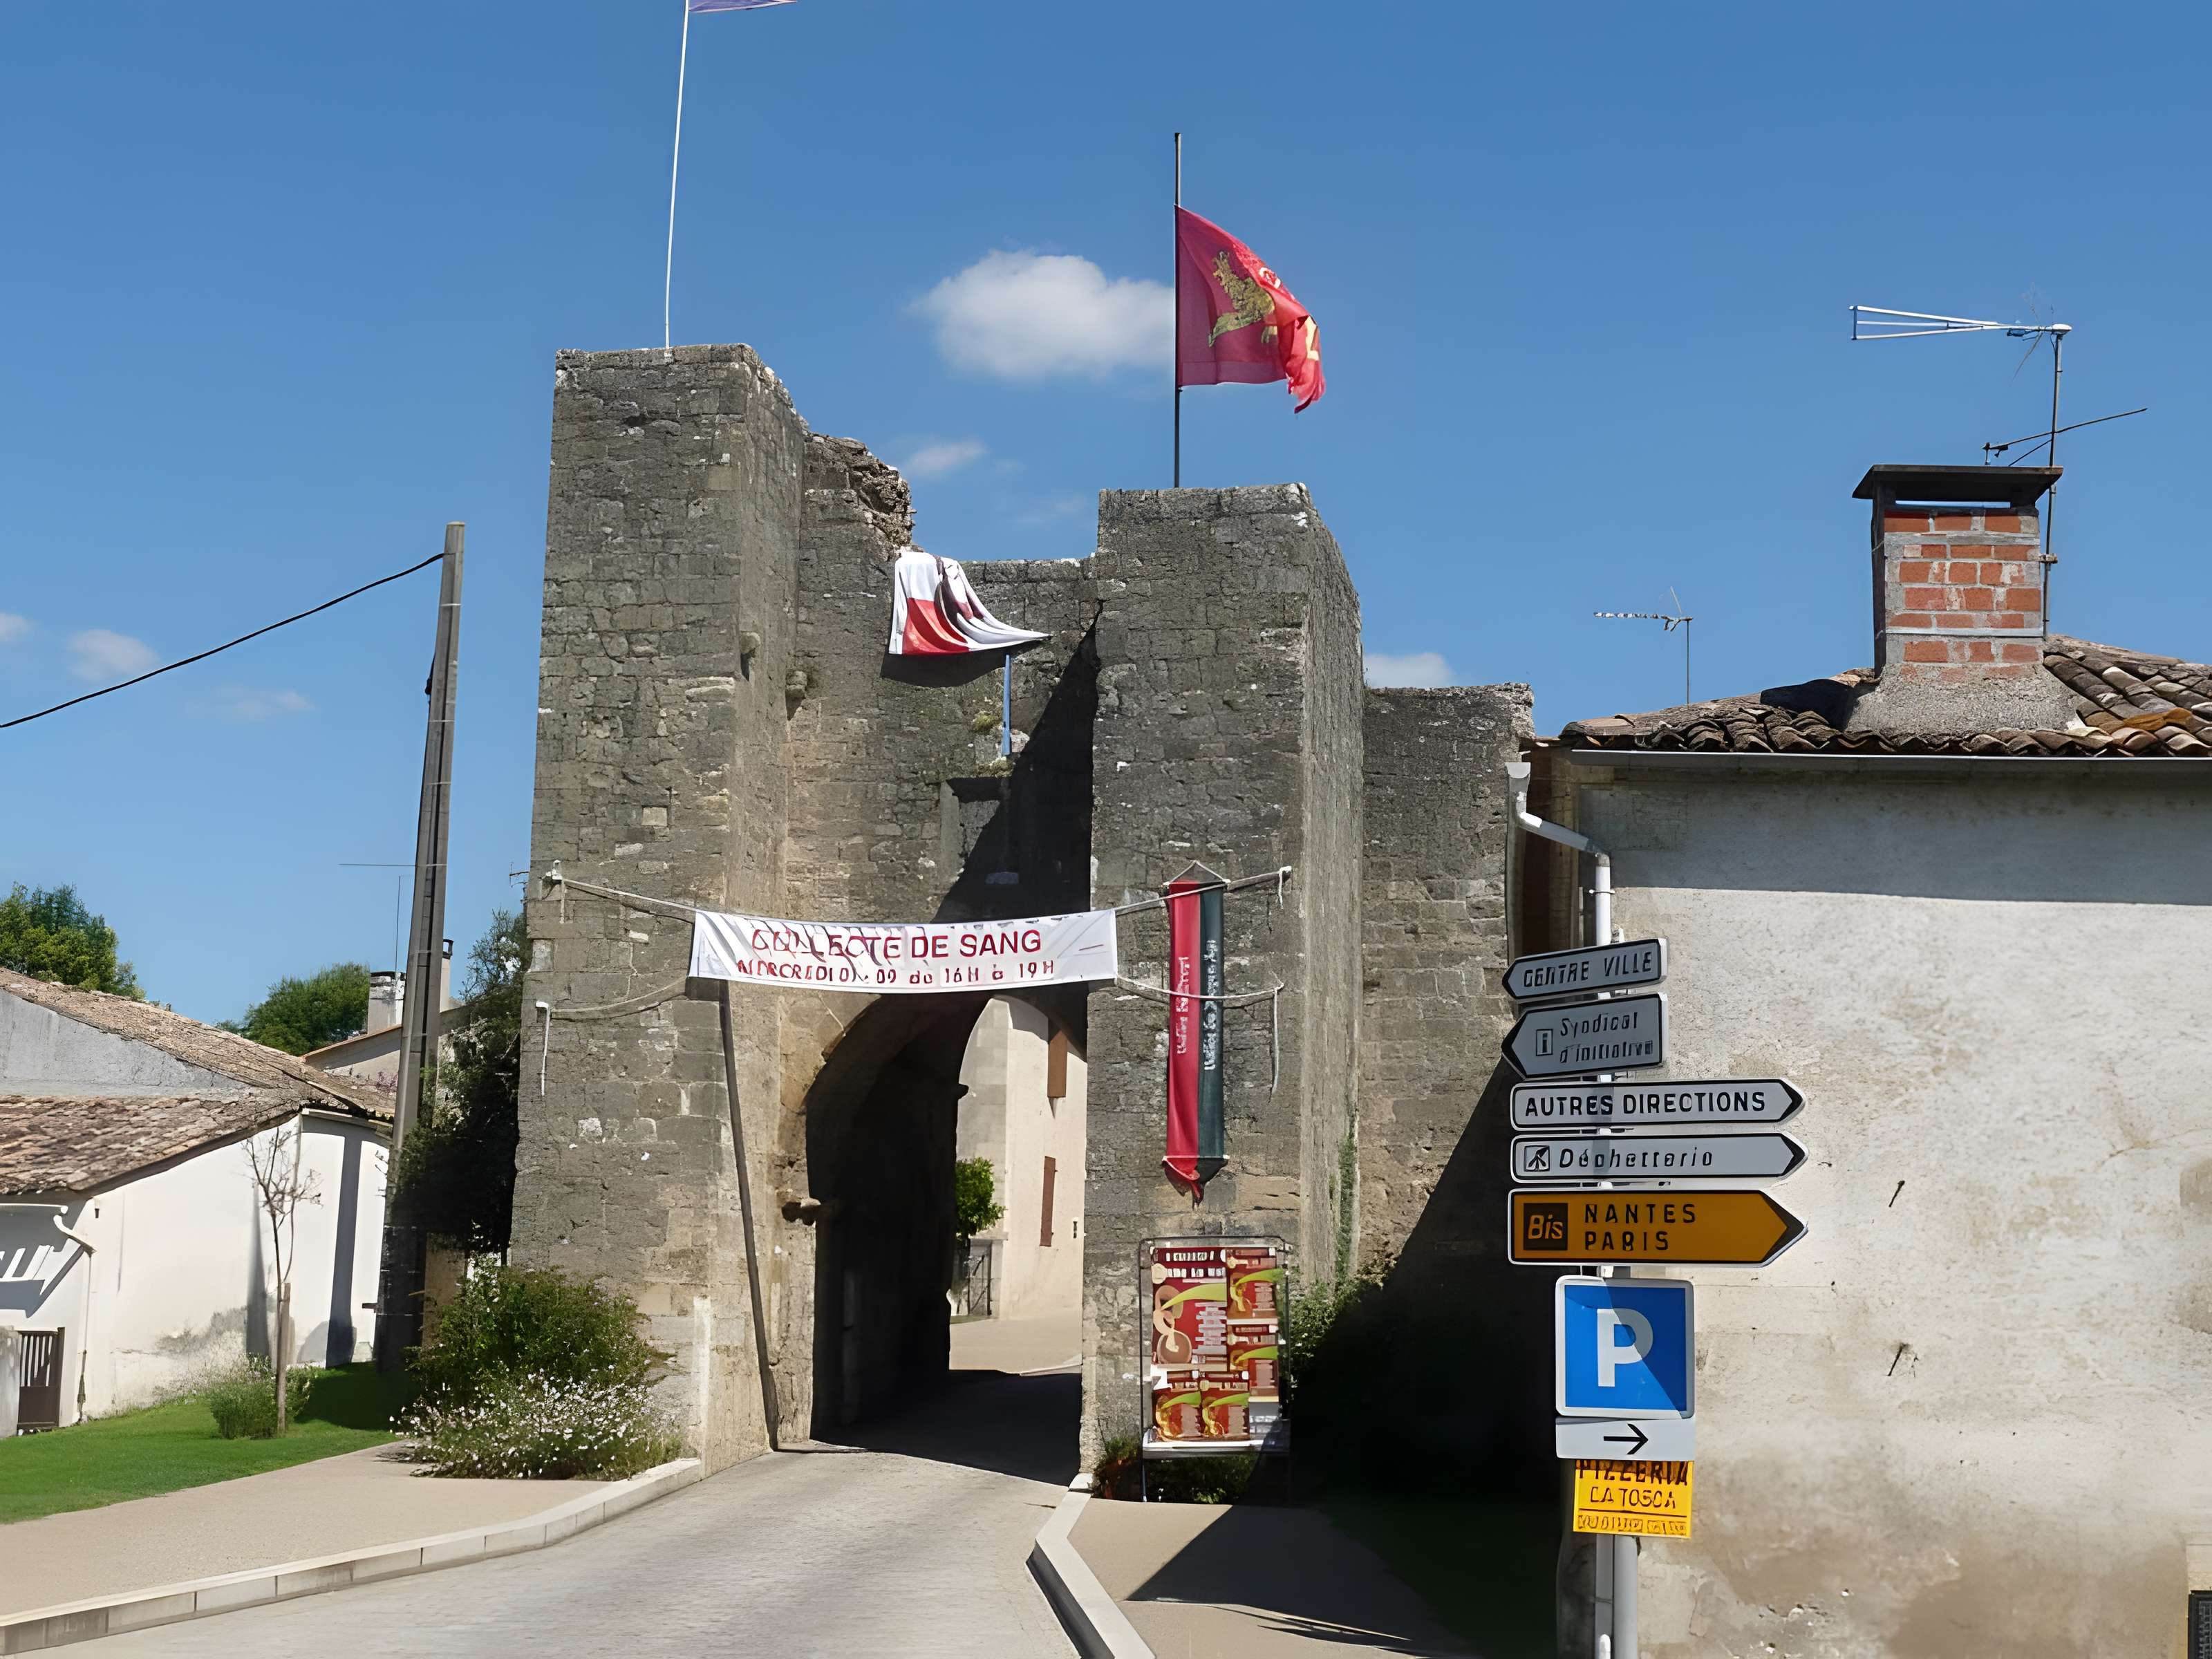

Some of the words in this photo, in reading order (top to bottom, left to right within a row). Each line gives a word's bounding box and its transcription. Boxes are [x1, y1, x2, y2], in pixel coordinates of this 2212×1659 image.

[752, 929, 901, 960] COLLECTE
[912, 935, 948, 958] DE
[960, 930, 1041, 957] SANG
[1524, 961, 1589, 988] CENTRE
[1604, 952, 1651, 977] VILLE
[1525, 1096, 1613, 1116] AUTRES
[1624, 1092, 1765, 1114] DIRECTIONS
[1559, 1147, 1712, 1168] Déchetterie
[1584, 1203, 1695, 1224] NANTES
[1528, 1214, 1563, 1239] Bis
[1584, 1230, 1668, 1250] PARIS
[1597, 1308, 1653, 1387] P
[1591, 1487, 1613, 1503] LA
